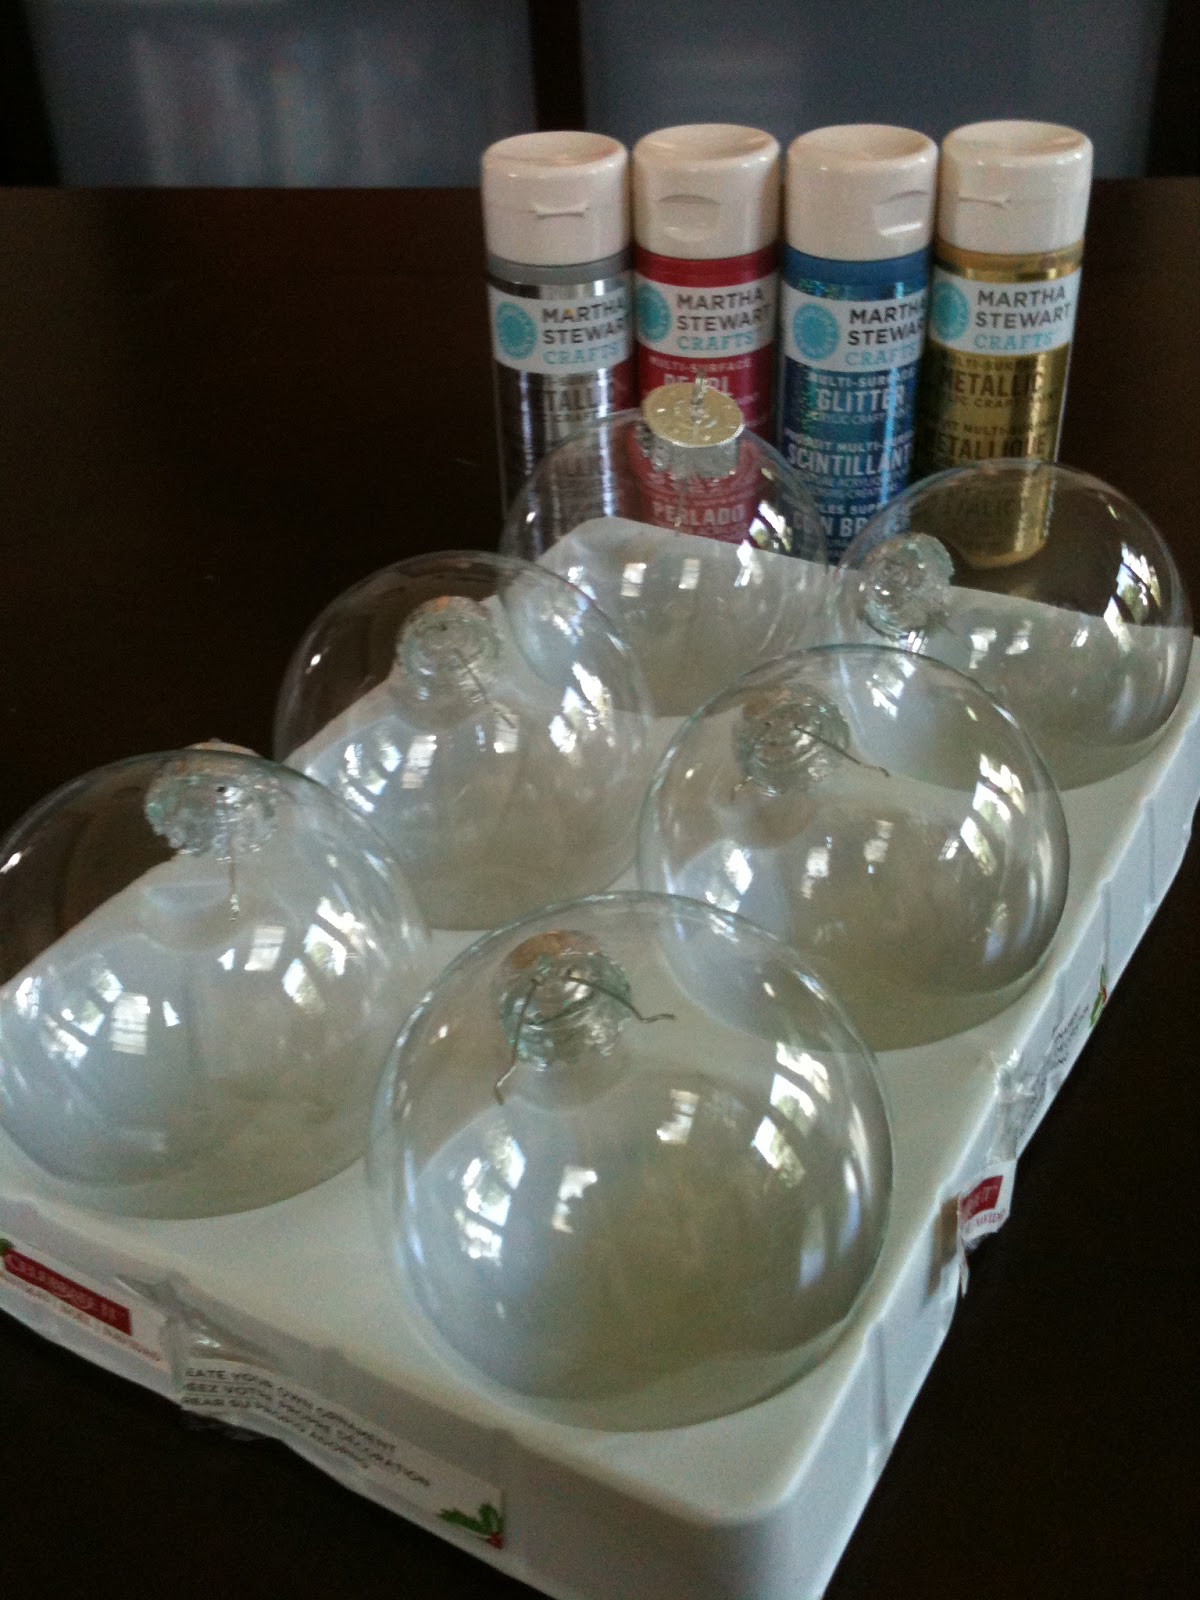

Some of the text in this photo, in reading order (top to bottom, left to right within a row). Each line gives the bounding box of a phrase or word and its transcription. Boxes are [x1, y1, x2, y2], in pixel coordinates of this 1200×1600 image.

[677, 287, 764, 310] MARTHA
[977, 285, 1067, 308] MARTHA
[975, 302, 1072, 329] STEWART
